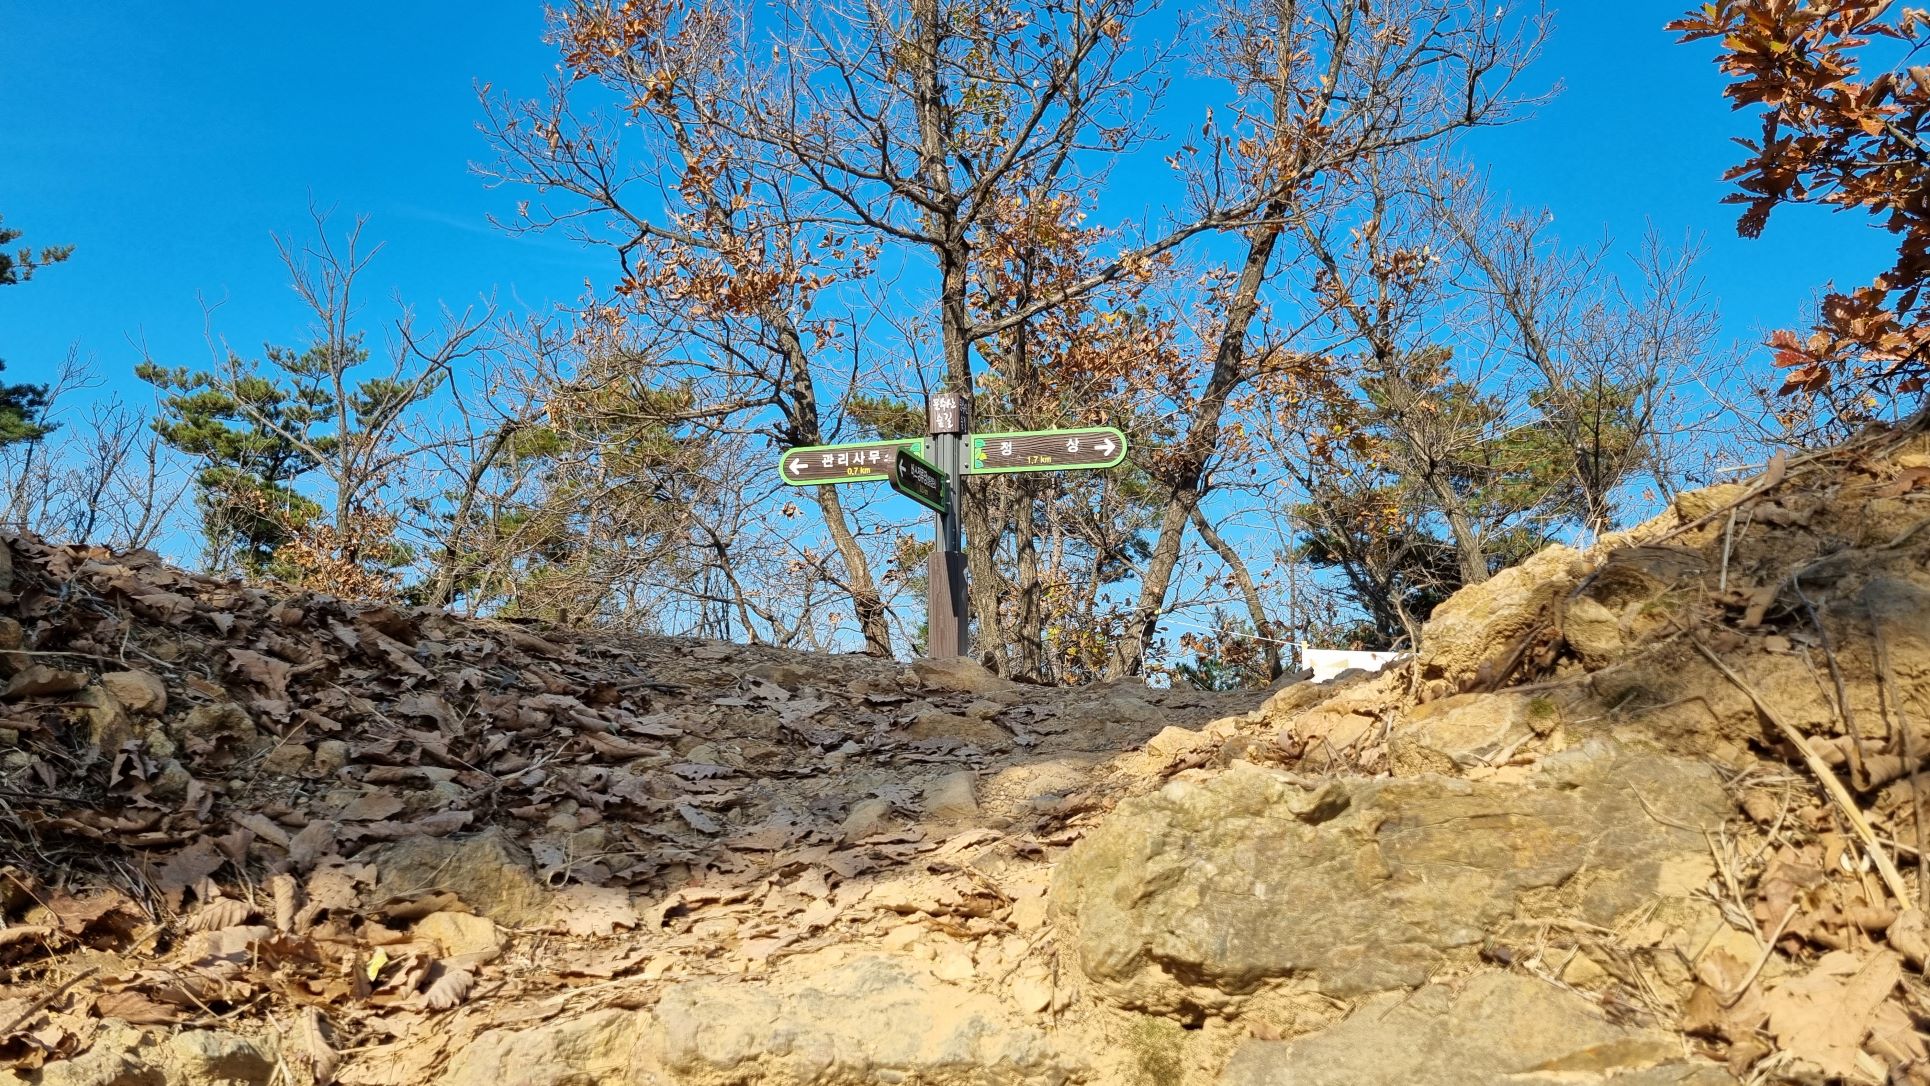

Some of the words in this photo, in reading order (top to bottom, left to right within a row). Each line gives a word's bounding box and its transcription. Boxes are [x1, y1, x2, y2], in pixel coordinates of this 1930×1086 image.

[1000, 441, 1012, 456] 정
[1066, 438, 1080, 453] 상
[1027, 456, 1039, 464] 1.7
[847, 467, 859, 475] 0.7
[860, 467, 871, 475] km
